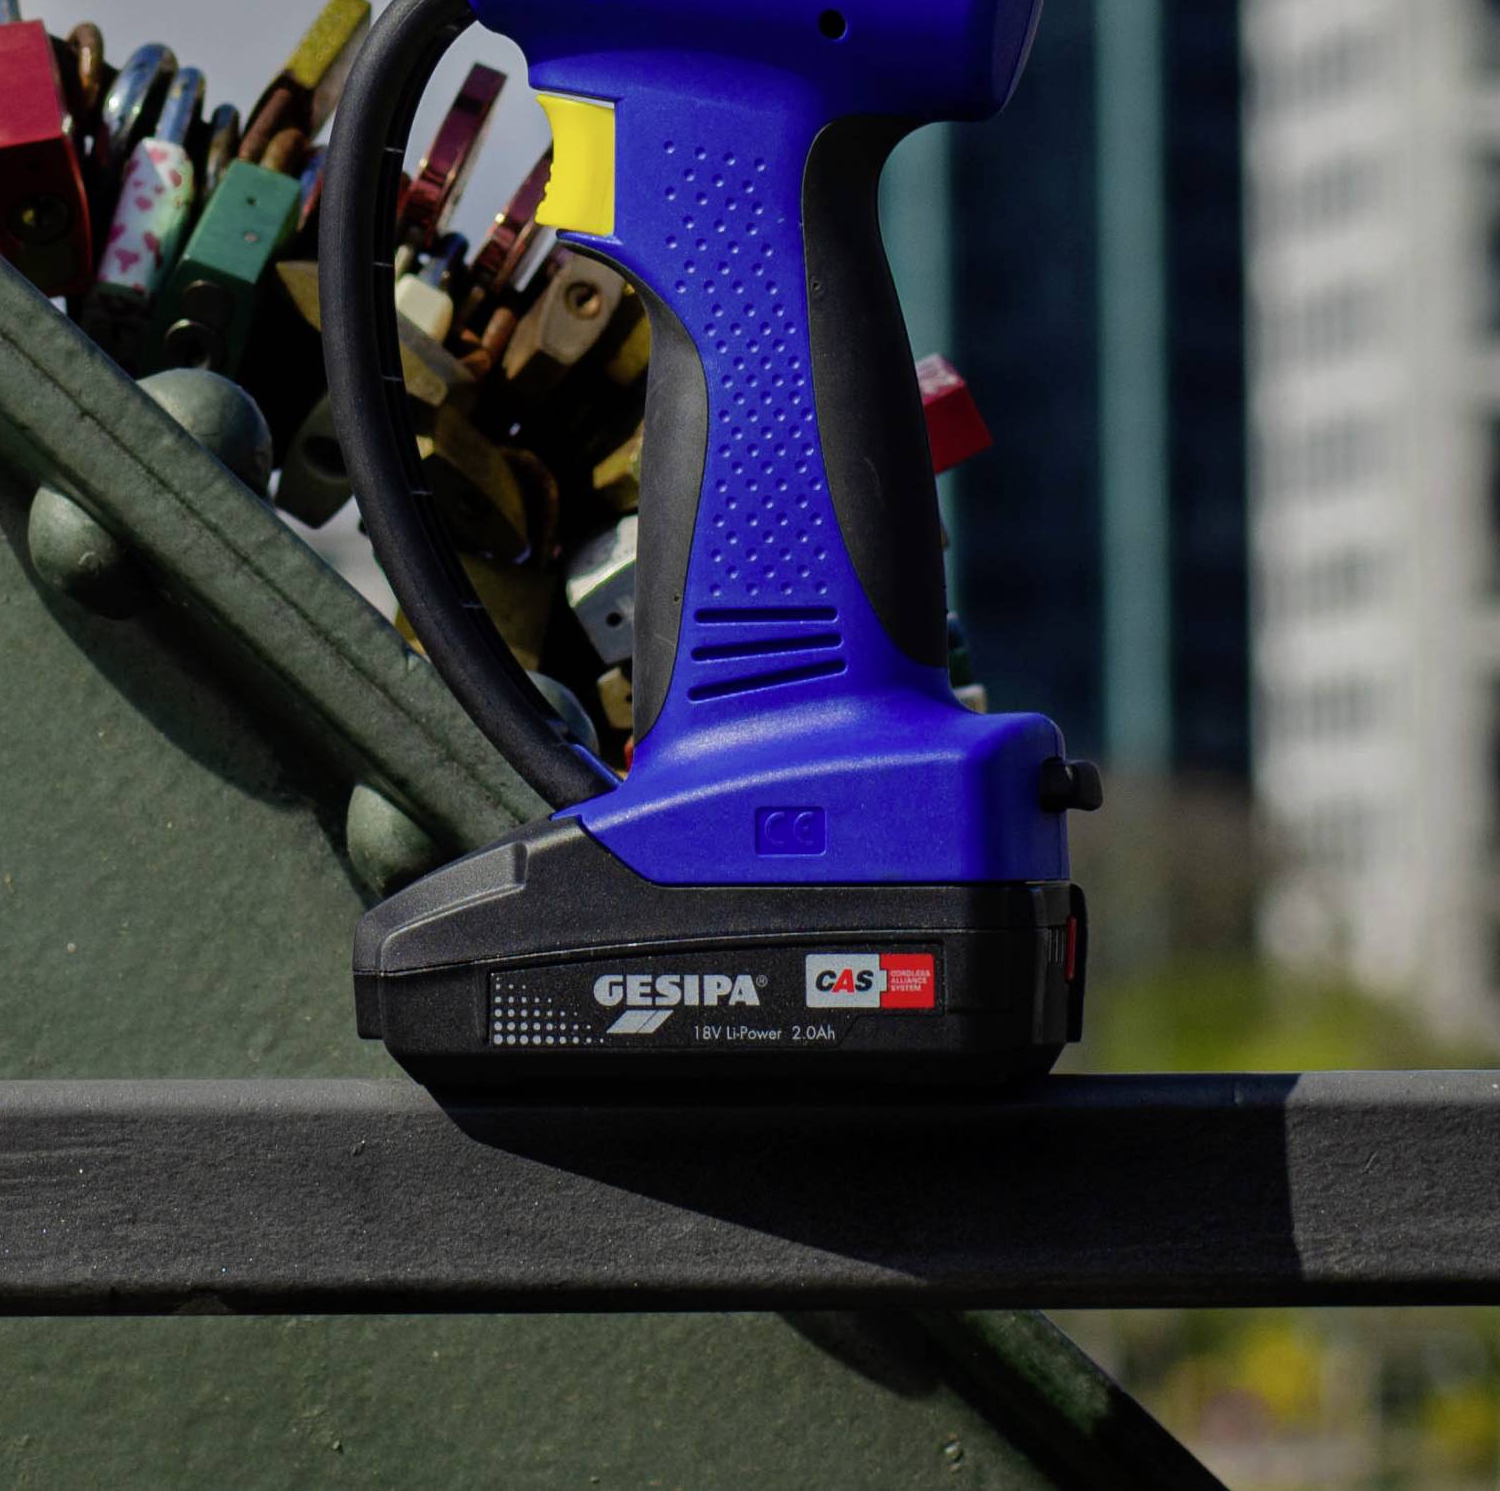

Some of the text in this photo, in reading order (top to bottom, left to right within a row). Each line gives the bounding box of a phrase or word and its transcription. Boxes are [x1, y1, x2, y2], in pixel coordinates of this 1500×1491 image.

[764, 811, 814, 846] CE
[815, 968, 874, 993] CAS
[693, 1025, 836, 1041] 18V Li-Power 2.0Ah
